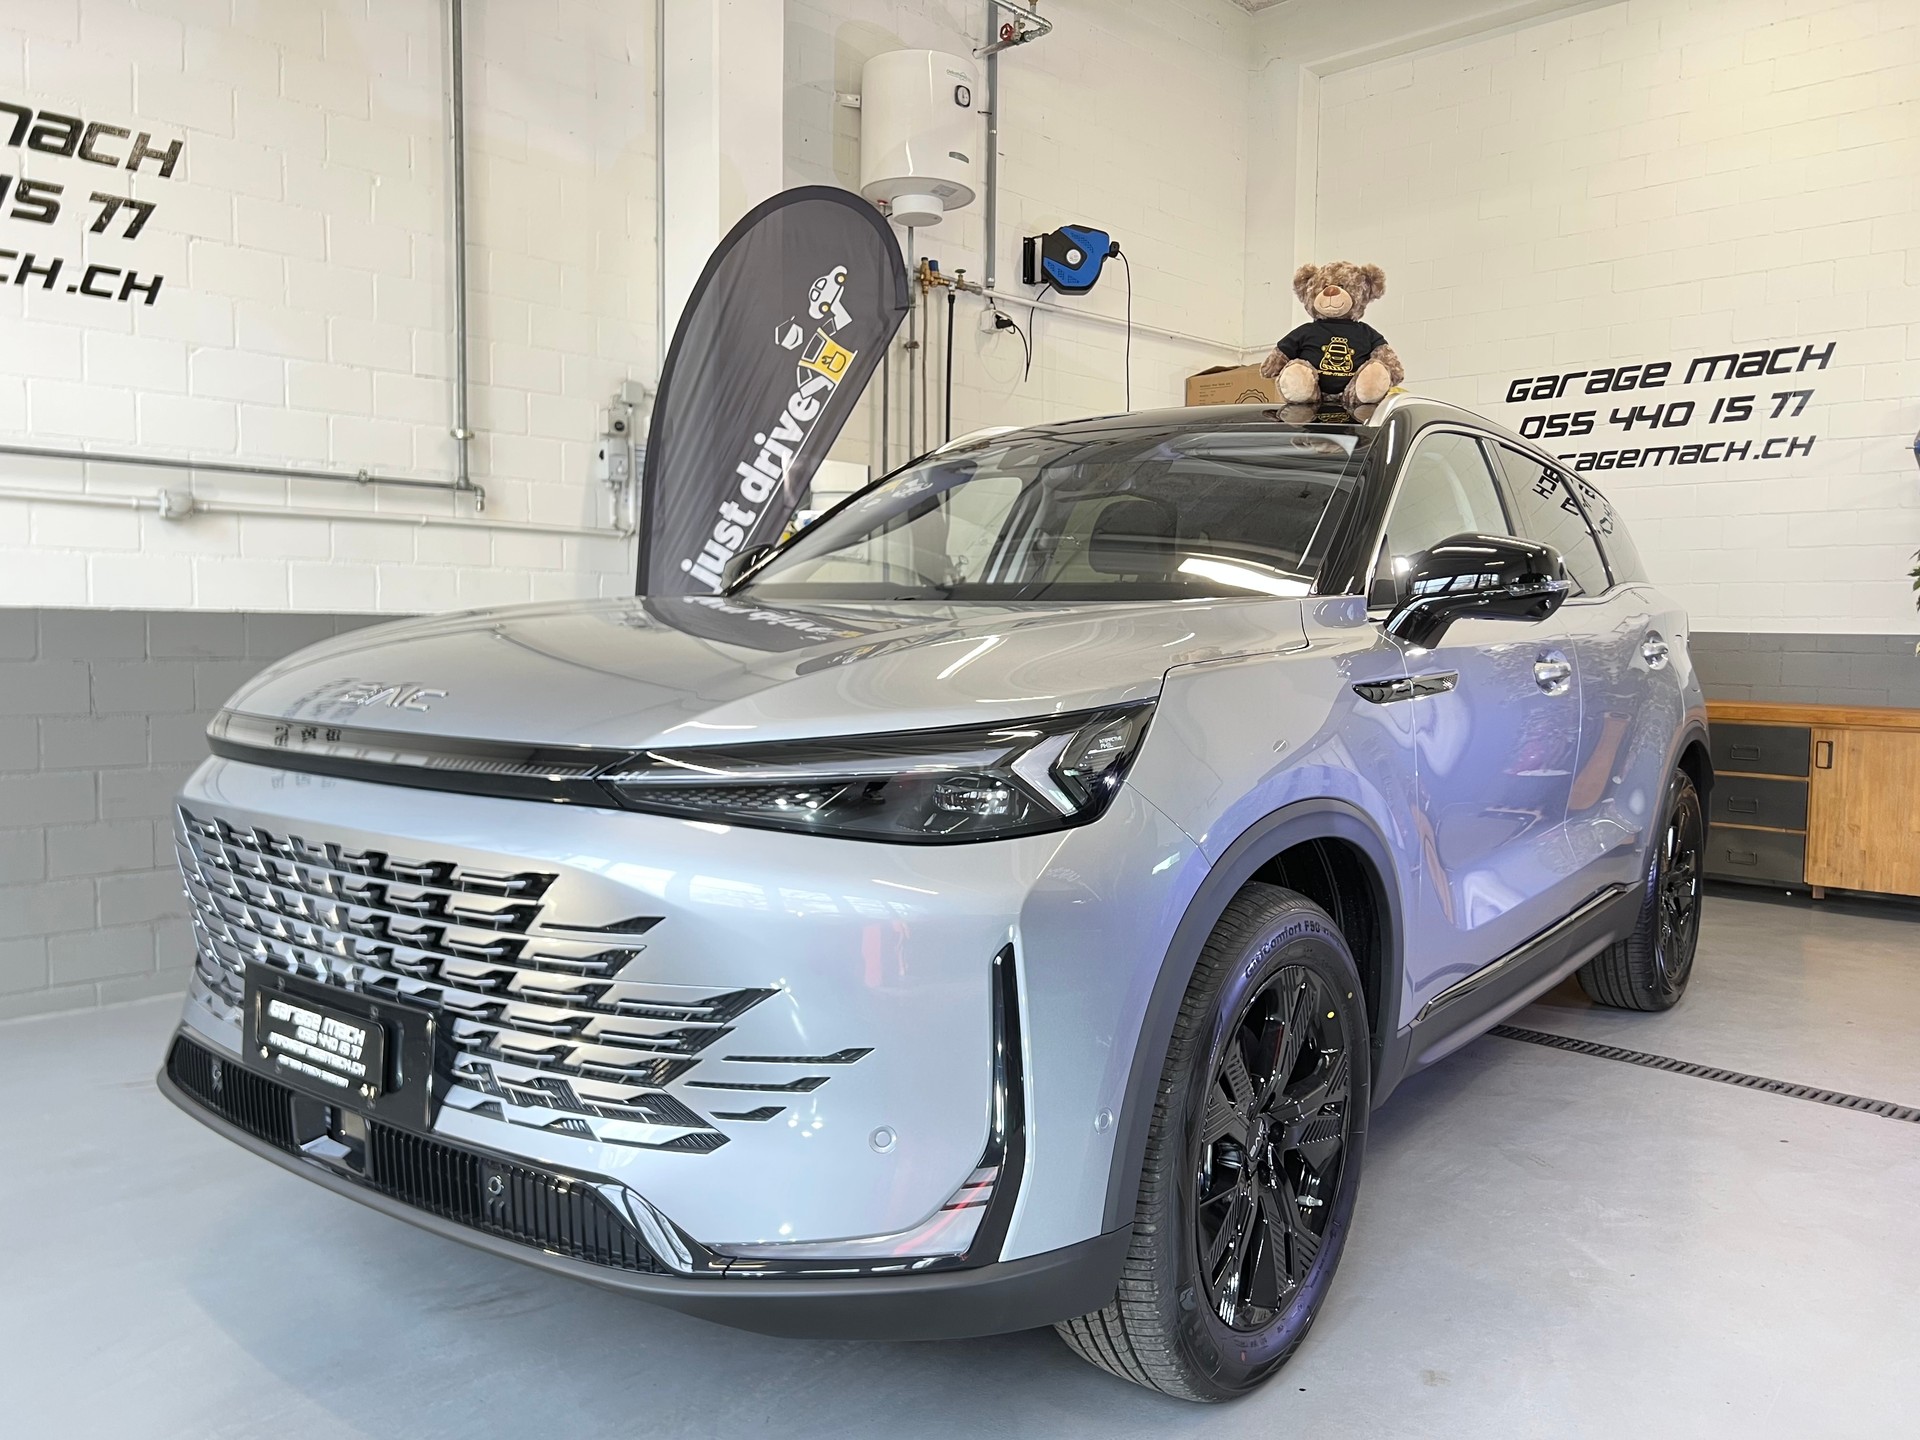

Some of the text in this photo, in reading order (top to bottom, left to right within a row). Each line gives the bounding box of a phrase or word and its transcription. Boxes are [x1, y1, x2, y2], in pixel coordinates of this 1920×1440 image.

[89, 191, 157, 240] 77
[1519, 389, 1815, 440] 055 440 15 77
[680, 501, 757, 594] just
